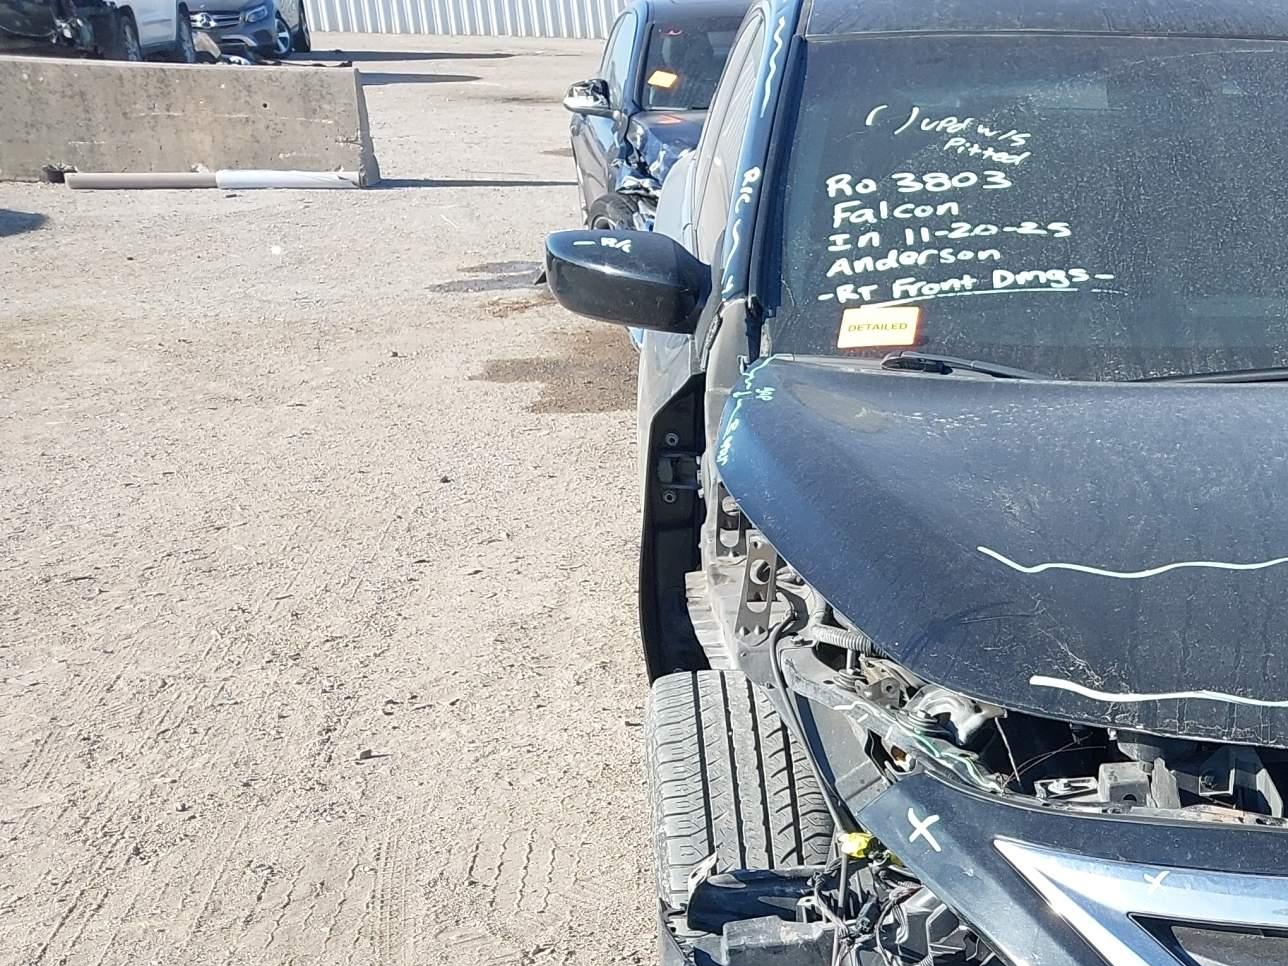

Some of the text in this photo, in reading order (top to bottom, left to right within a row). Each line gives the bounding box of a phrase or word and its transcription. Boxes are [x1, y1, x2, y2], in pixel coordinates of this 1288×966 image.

[892, 170, 1012, 192] 3803
[833, 200, 959, 228] Falcon
[828, 222, 1072, 251] In 11-20-25
[826, 247, 1001, 276] Anderson
[892, 276, 976, 299] Front
[848, 323, 908, 332] DETAILED
